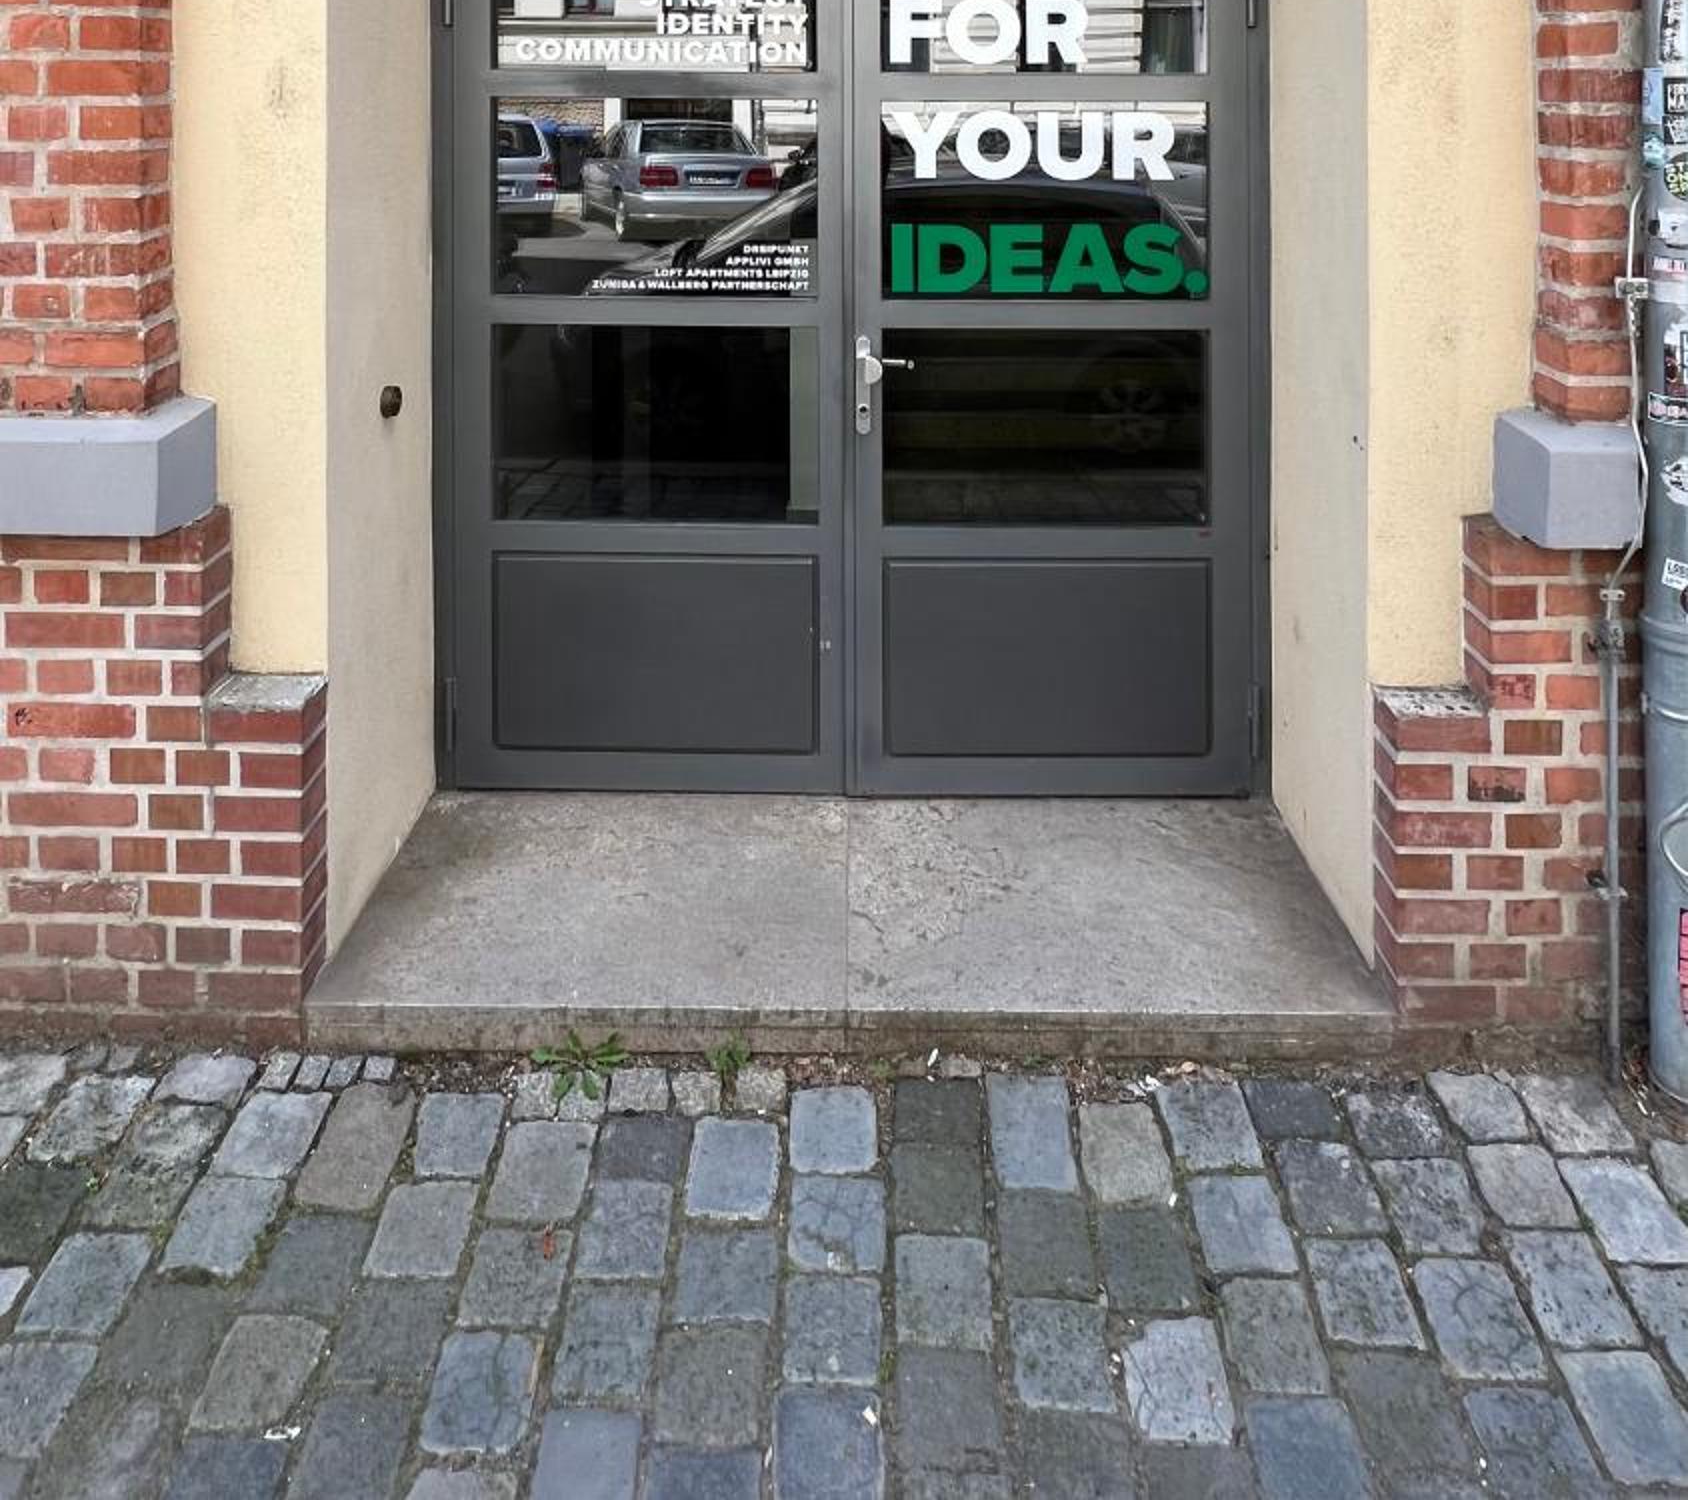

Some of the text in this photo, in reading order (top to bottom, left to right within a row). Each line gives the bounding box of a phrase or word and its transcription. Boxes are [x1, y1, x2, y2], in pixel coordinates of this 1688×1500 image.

[656, 12, 808, 35] IDENTITY
[516, 38, 808, 63] COMMUNICATION
[882, 111, 1175, 181] YOUR
[743, 244, 810, 254] DREIPUNKT
[773, 256, 810, 266] GMBH
[891, 223, 1210, 295] IDEAS.
[654, 267, 810, 279] LOFT APARTMENTS LEIPZIG
[711, 280, 810, 291] PARTNERSCHAFT
